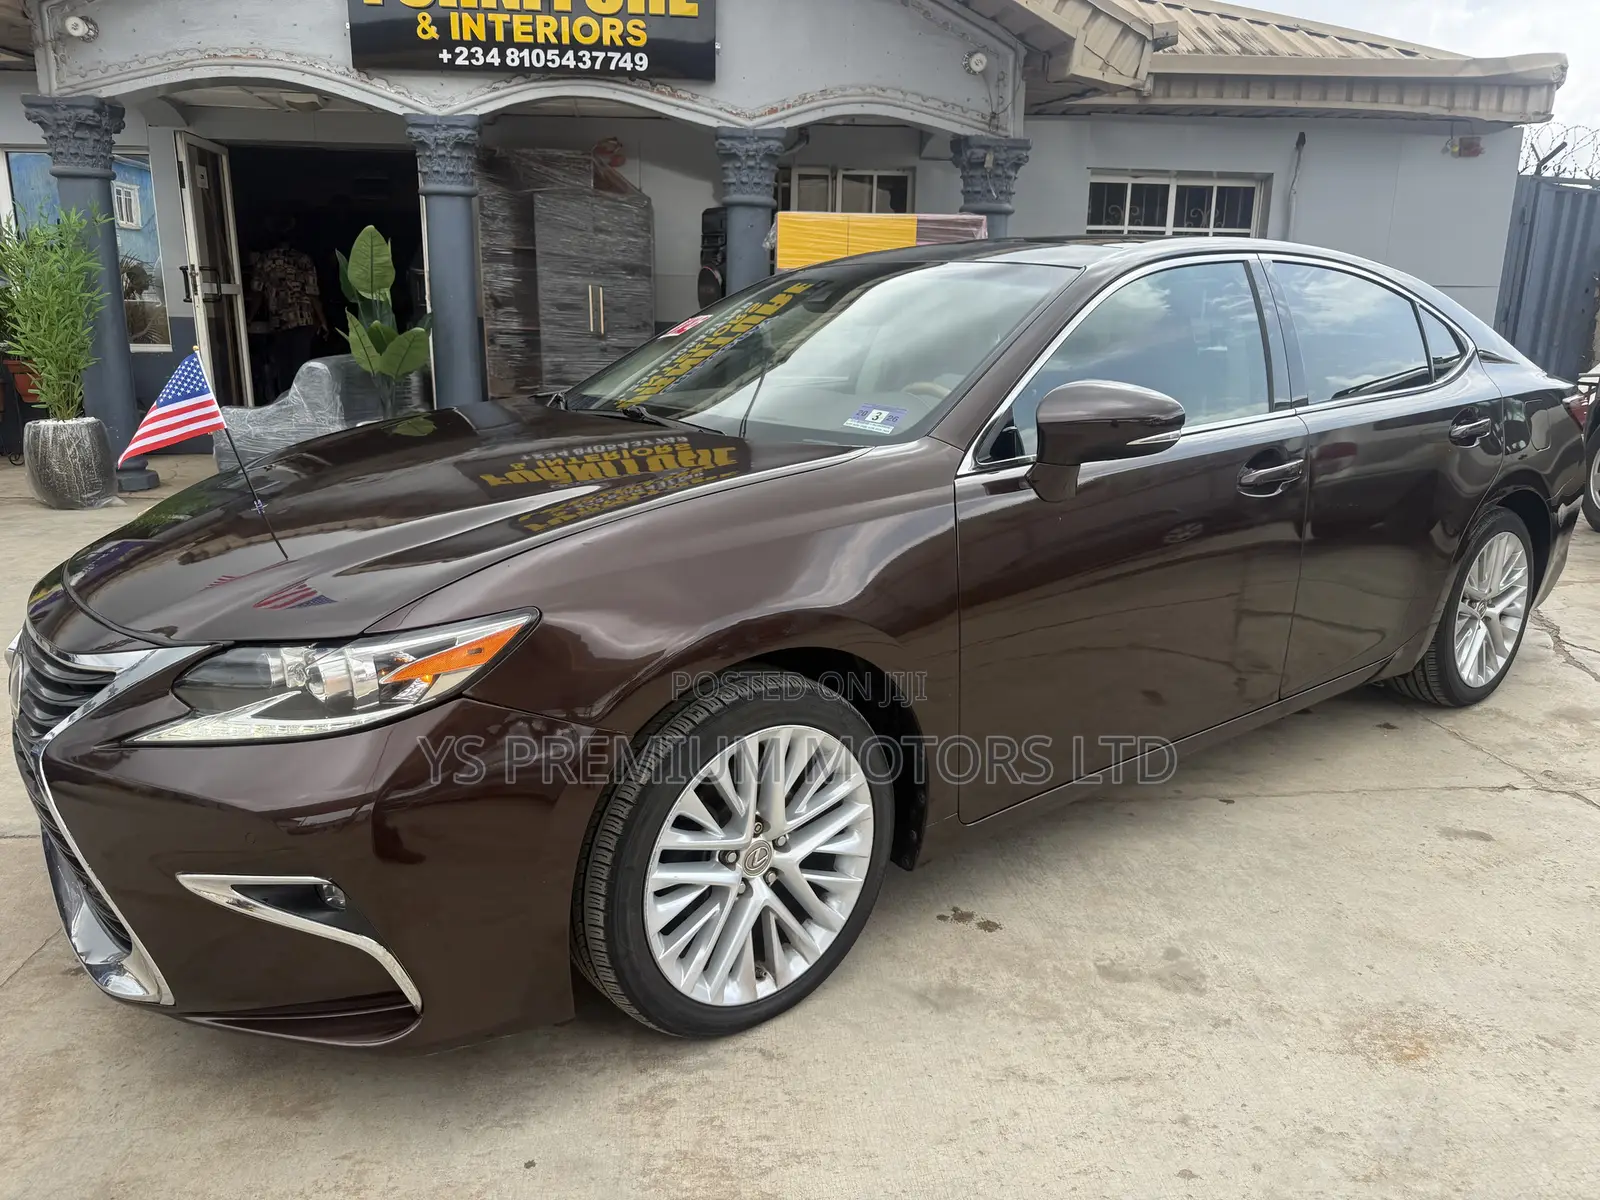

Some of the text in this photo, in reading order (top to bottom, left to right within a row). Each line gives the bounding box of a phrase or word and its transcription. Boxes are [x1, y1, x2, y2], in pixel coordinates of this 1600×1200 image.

[416, 11, 648, 48] & INTERIORS
[438, 46, 649, 71] +234 8105437749
[871, 411, 883, 421] 3
